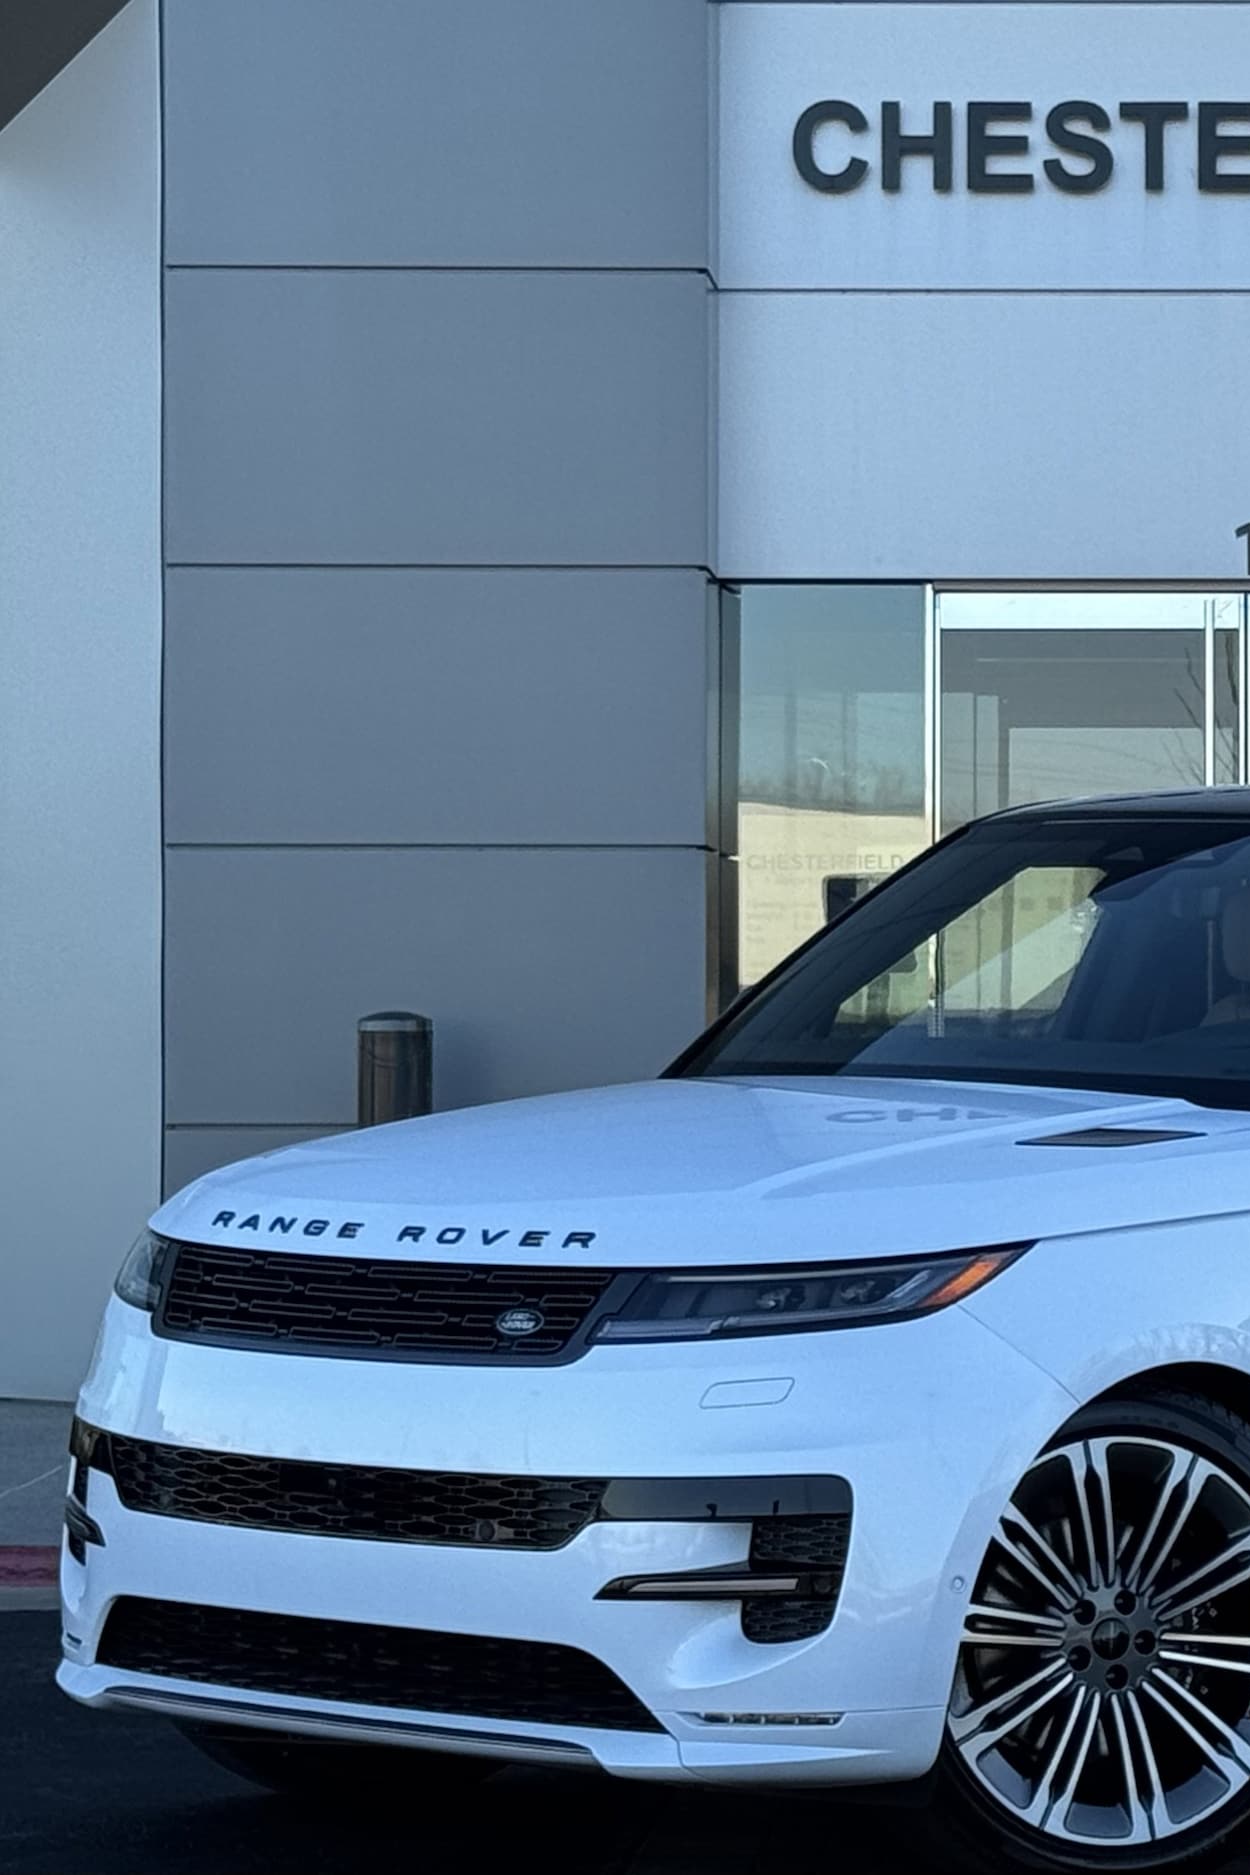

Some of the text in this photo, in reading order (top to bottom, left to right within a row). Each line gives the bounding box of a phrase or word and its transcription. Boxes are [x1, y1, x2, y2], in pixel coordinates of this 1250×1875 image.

[746, 854, 904, 871] CHESTERFIELD
[212, 1211, 597, 1248] RANGE ROVER
